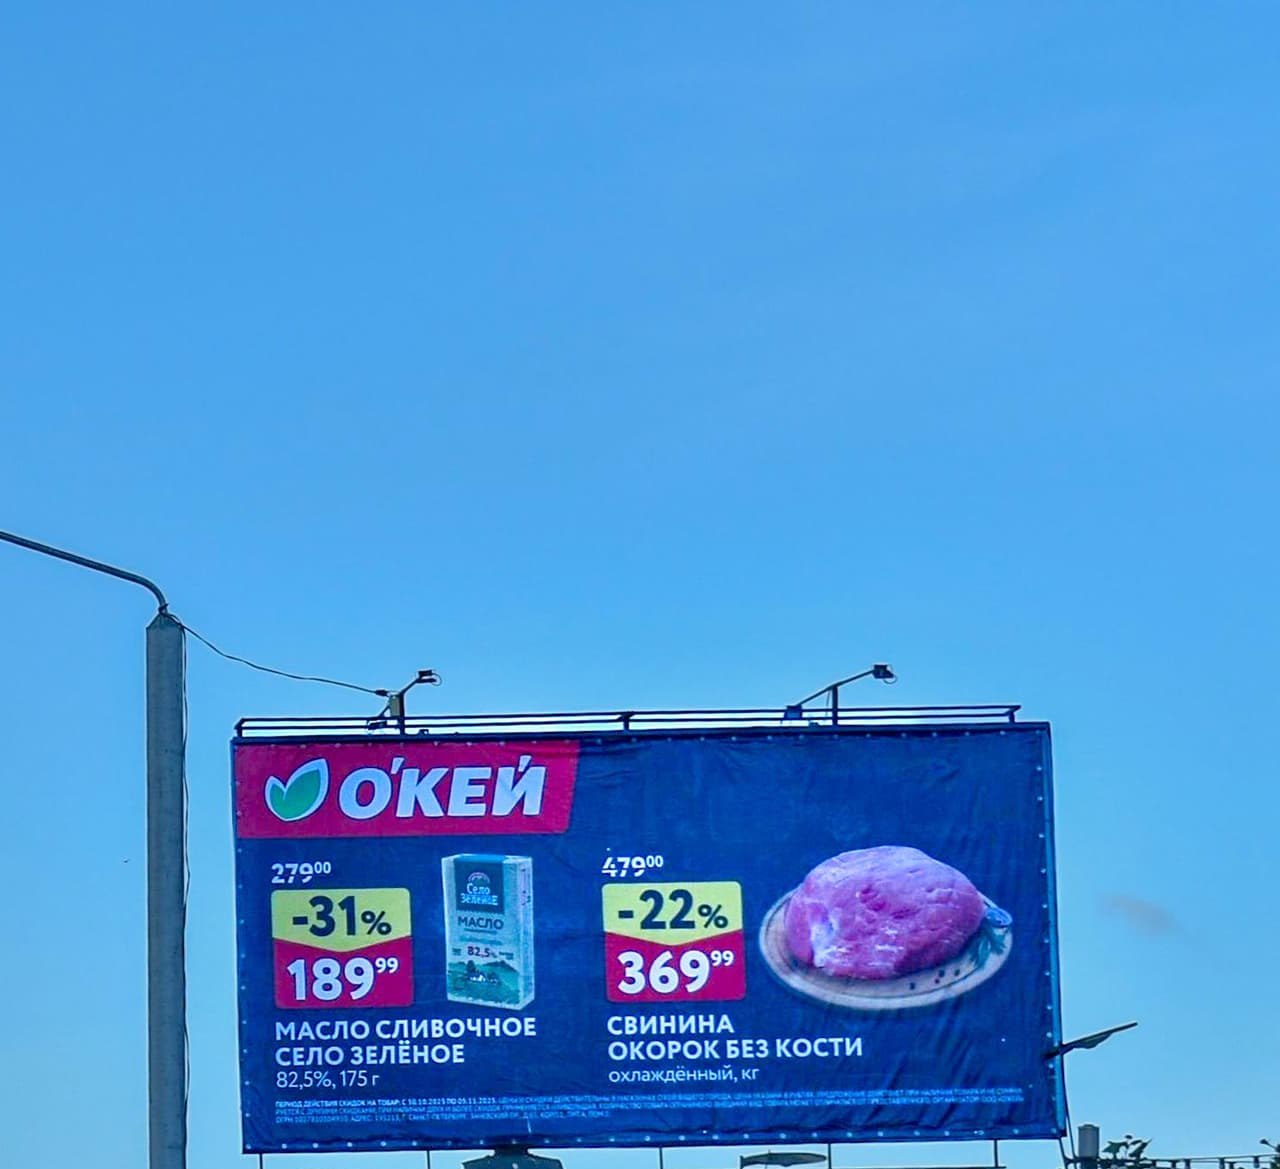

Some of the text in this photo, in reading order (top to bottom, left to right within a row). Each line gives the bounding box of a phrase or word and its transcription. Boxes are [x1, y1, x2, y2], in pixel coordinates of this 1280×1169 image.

[292, 895, 391, 937] -31%
[618, 889, 729, 930] -22%
[458, 916, 504, 930] МАСЛО
[275, 1017, 537, 1040] МАСЛО СЛИВОЧНОЕ
[607, 1014, 734, 1035] СВИНИНА
[275, 1039, 465, 1066] СЕЛО ЗЕЛЁНОЕ
[608, 1038, 863, 1060] ОКОРОК БЕЗ КОСТИ
[276, 1070, 380, 1090] 82,5%, 175 г
[608, 1065, 759, 1083] охлаждённый, кг
